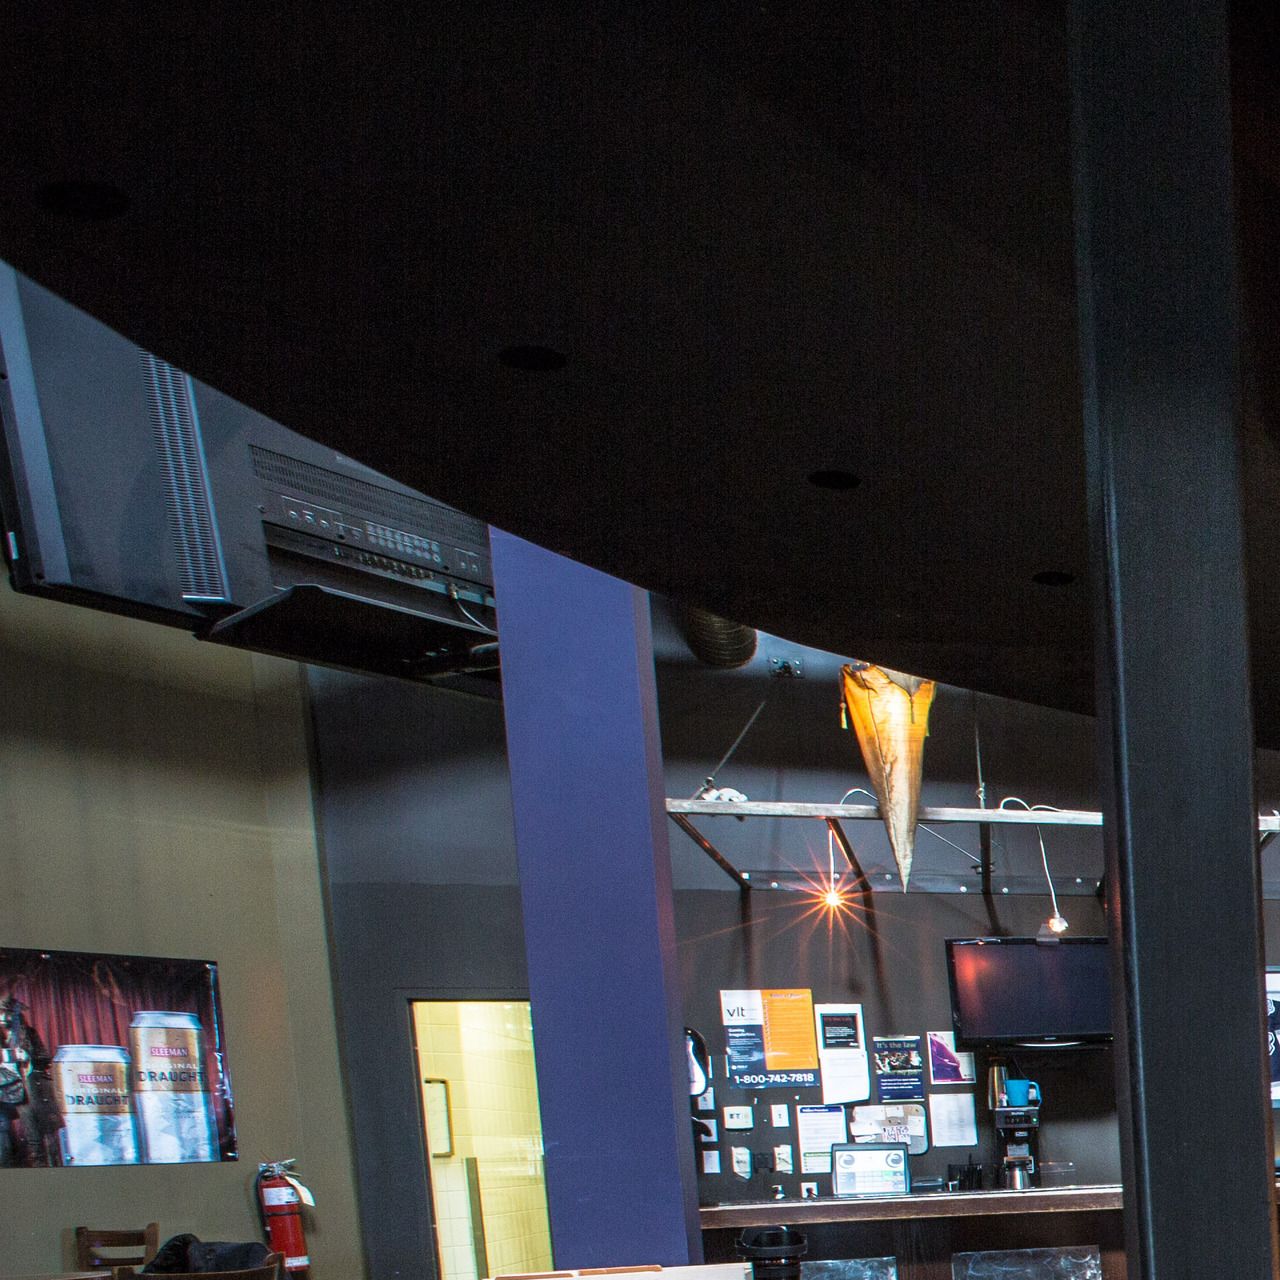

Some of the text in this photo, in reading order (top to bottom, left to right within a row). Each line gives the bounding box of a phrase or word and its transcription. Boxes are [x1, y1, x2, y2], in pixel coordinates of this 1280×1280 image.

[151, 1047, 188, 1056] SLEEMAN
[78, 1074, 113, 1083] SLEEMAN
[138, 1071, 206, 1082] DRAUGHT
[734, 1073, 815, 1084] 1-800-742-7818
[65, 1095, 129, 1106] DRAUGHT
